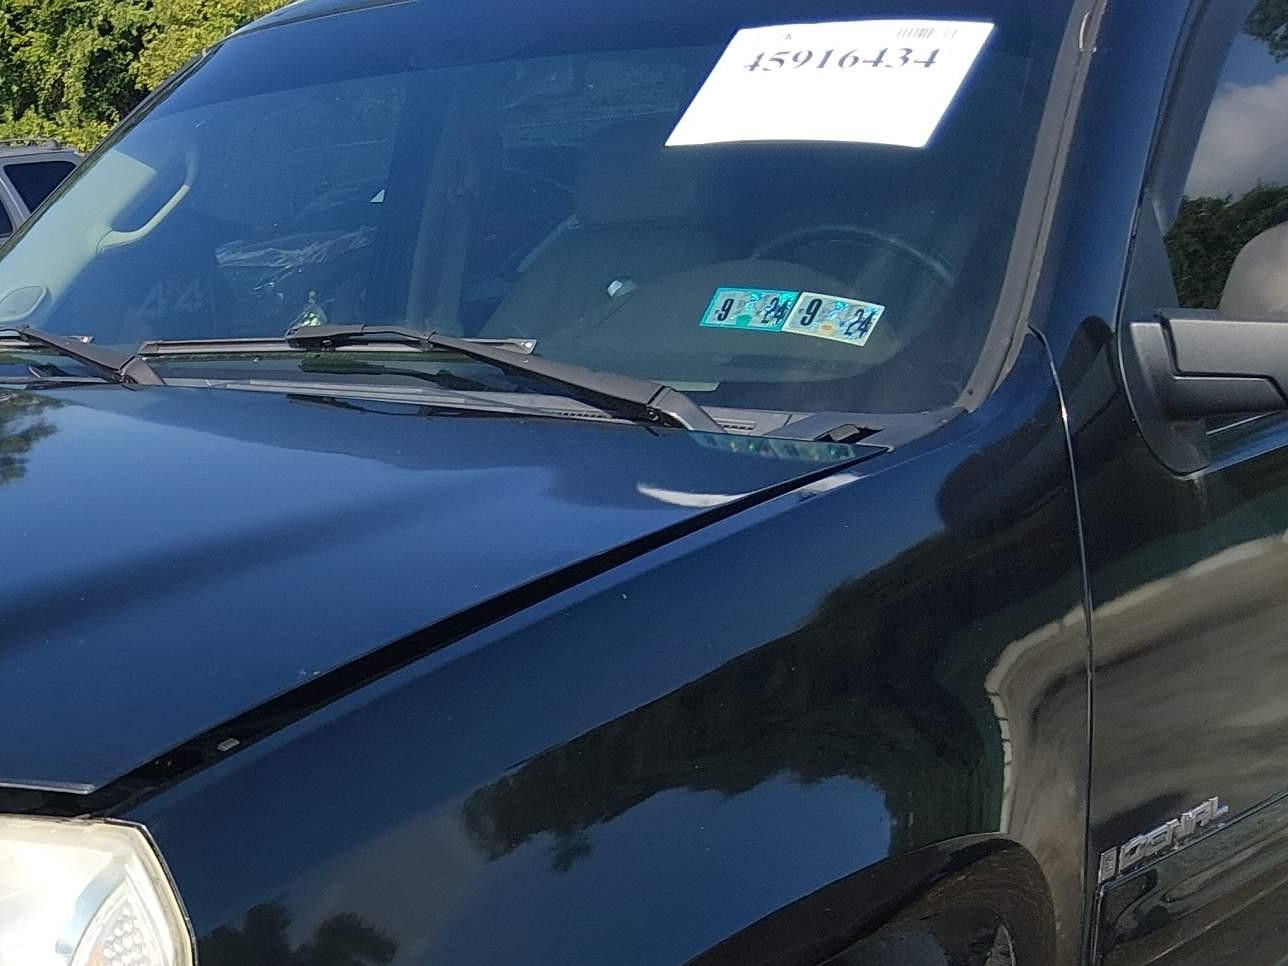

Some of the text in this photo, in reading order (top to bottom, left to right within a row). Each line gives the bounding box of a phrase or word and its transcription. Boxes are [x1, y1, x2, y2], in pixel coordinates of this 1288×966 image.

[745, 47, 941, 72] 45916434
[717, 298, 734, 322] 9
[800, 298, 876, 338] 9 24
